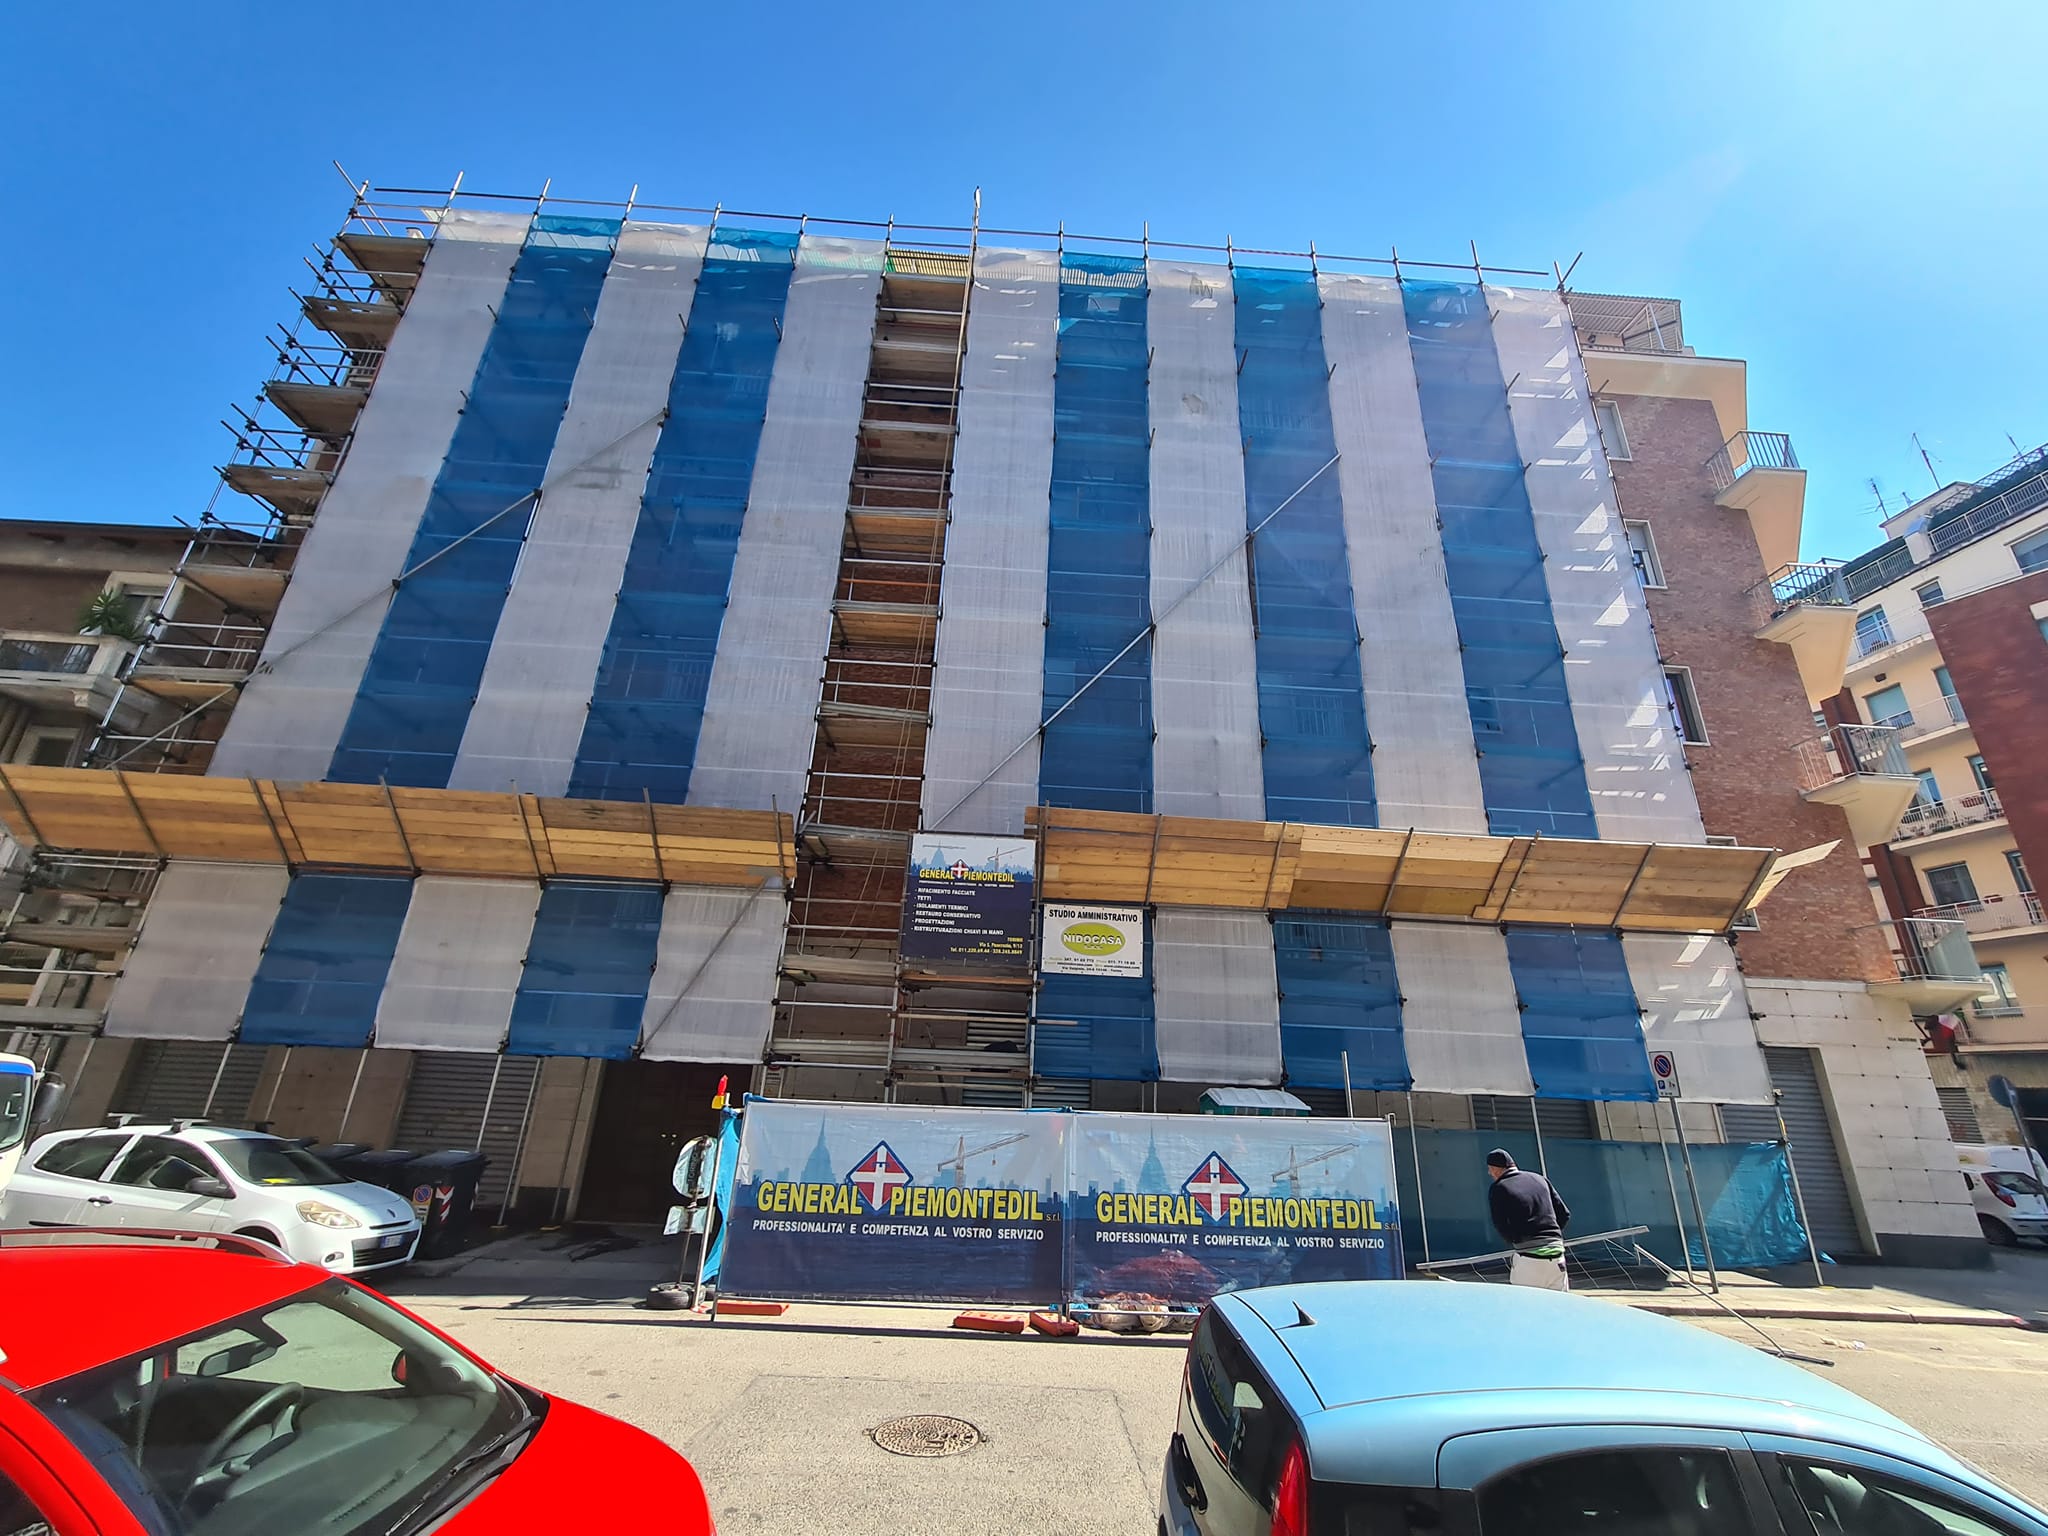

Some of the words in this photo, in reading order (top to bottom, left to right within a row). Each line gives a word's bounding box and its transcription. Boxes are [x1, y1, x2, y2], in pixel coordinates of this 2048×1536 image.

[919, 869, 955, 879] GENERAL
[963, 871, 1015, 882] PIEMONTEDIL
[943, 911, 981, 919] CONSERVATIVO
[1049, 909, 1076, 918] STUDIO
[1077, 911, 1138, 922] AMMINISTRATIVO
[915, 918, 955, 926] PROGETTAZIONI
[914, 926, 963, 934] RISTRUTTURAZIONI
[1063, 933, 1122, 945] NIDOCASA
[757, 1181, 863, 1215] GENERAL
[889, 1186, 1044, 1221] PIEMONTEDIL
[1096, 1192, 1203, 1226] GENERAL
[1229, 1197, 1382, 1230] PIEMONTEDIL
[752, 1219, 846, 1234] PROFESSIONALITA'
[850, 1223, 857, 1234] E
[862, 1223, 929, 1237] COMPETENZA
[934, 1226, 947, 1237] AL
[953, 1227, 993, 1239] VOSTRO
[997, 1228, 1044, 1241] SERVIZIO
[1095, 1231, 1188, 1244] PROFESSIONALITA'
[1193, 1234, 1199, 1245] E
[1204, 1235, 1272, 1247] COMPETENZA
[1277, 1236, 1290, 1247] AL
[1295, 1237, 1334, 1248] VOSTRO
[1339, 1238, 1385, 1249] SERVIZIO
